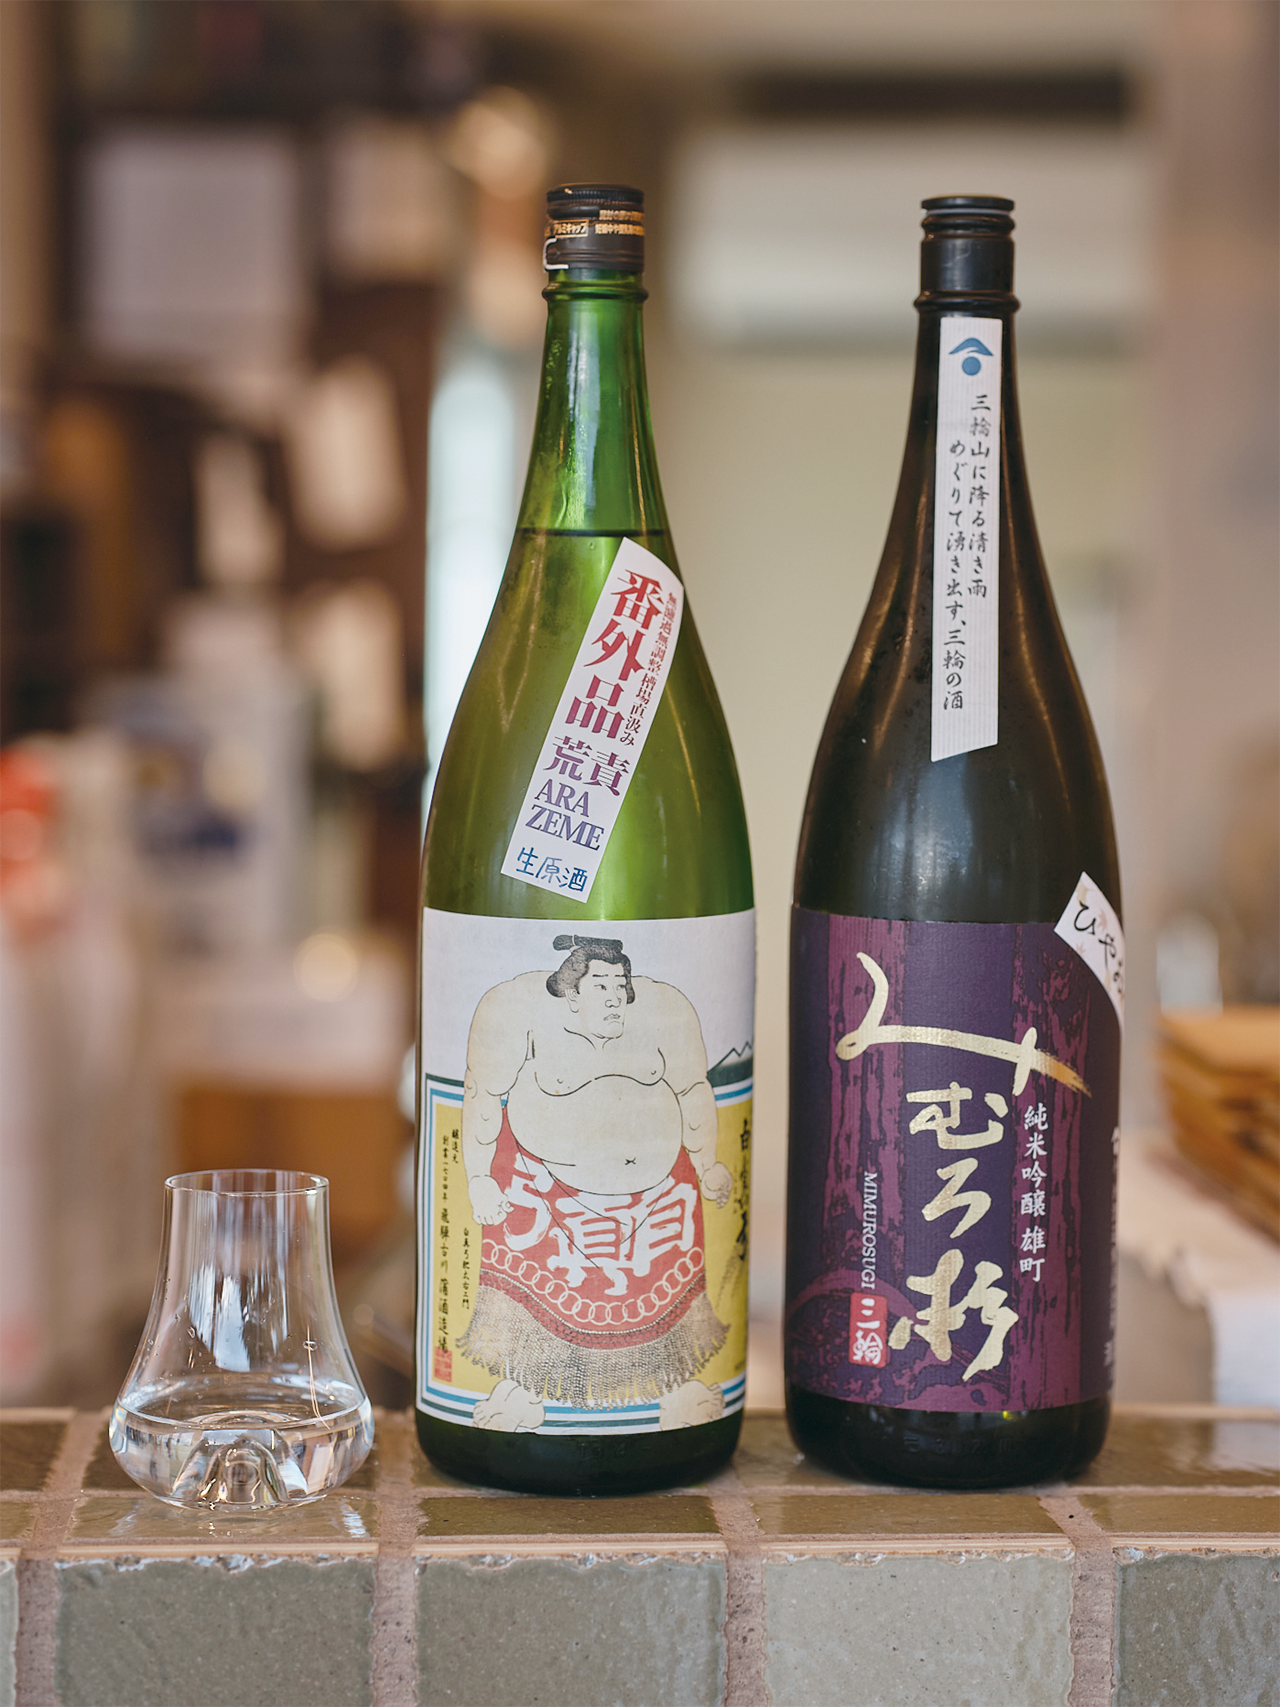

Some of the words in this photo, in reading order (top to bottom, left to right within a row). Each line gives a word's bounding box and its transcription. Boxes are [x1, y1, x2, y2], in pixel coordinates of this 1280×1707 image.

[968, 394, 992, 600] 三輪山に降る清き雨
[565, 568, 664, 739] 番外品
[534, 778, 590, 818] ARA
[542, 735, 630, 797] 荒責
[525, 804, 605, 852] ZEME
[515, 846, 588, 893] 生原酒
[835, 951, 1093, 1382] みむろ杉
[1020, 1102, 1048, 1218] 純米吟醸
[860, 1171, 878, 1290] MIMUROSUGI
[1019, 1225, 1047, 1284] 雄町
[852, 1297, 884, 1365] 三輪
